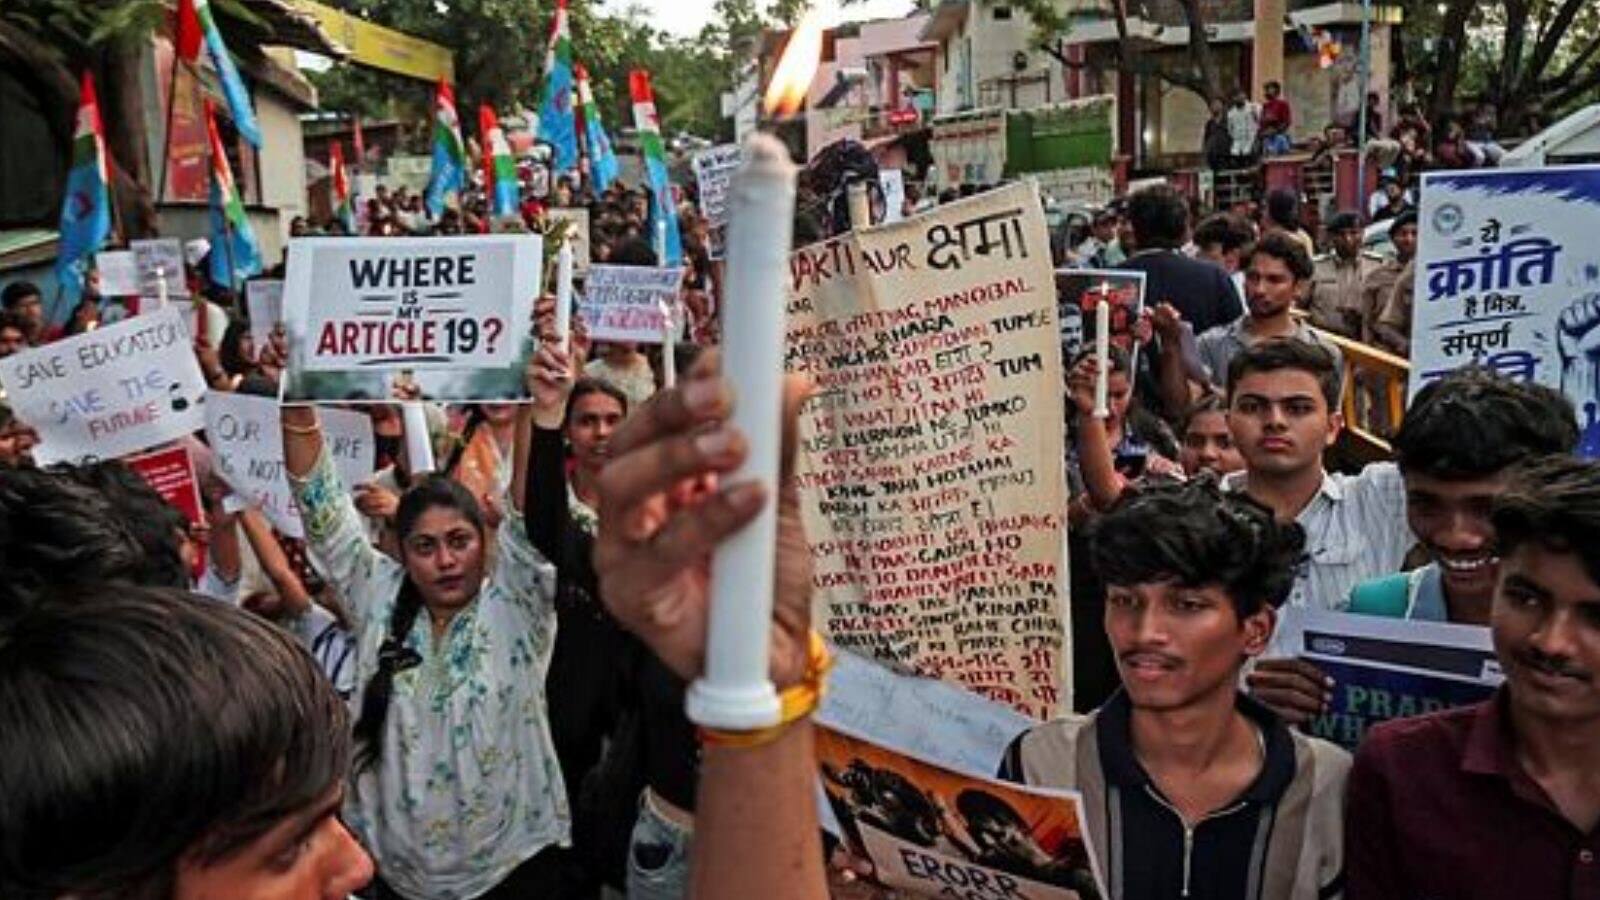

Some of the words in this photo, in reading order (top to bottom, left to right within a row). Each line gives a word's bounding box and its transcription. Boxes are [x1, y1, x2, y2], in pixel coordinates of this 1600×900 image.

[926, 208, 1029, 270] क्षमा
[349, 254, 476, 288] WHERE
[1426, 238, 1562, 301] क्रांति
[397, 306, 423, 319] MY
[402, 291, 418, 305] IS
[315, 320, 437, 355] ARTICLE
[444, 318, 504, 354] 19?
[1440, 321, 1512, 357] संपूर्ण
[14, 355, 66, 389] SAVE
[994, 352, 1043, 377] TUM
[249, 459, 284, 481] NOT
